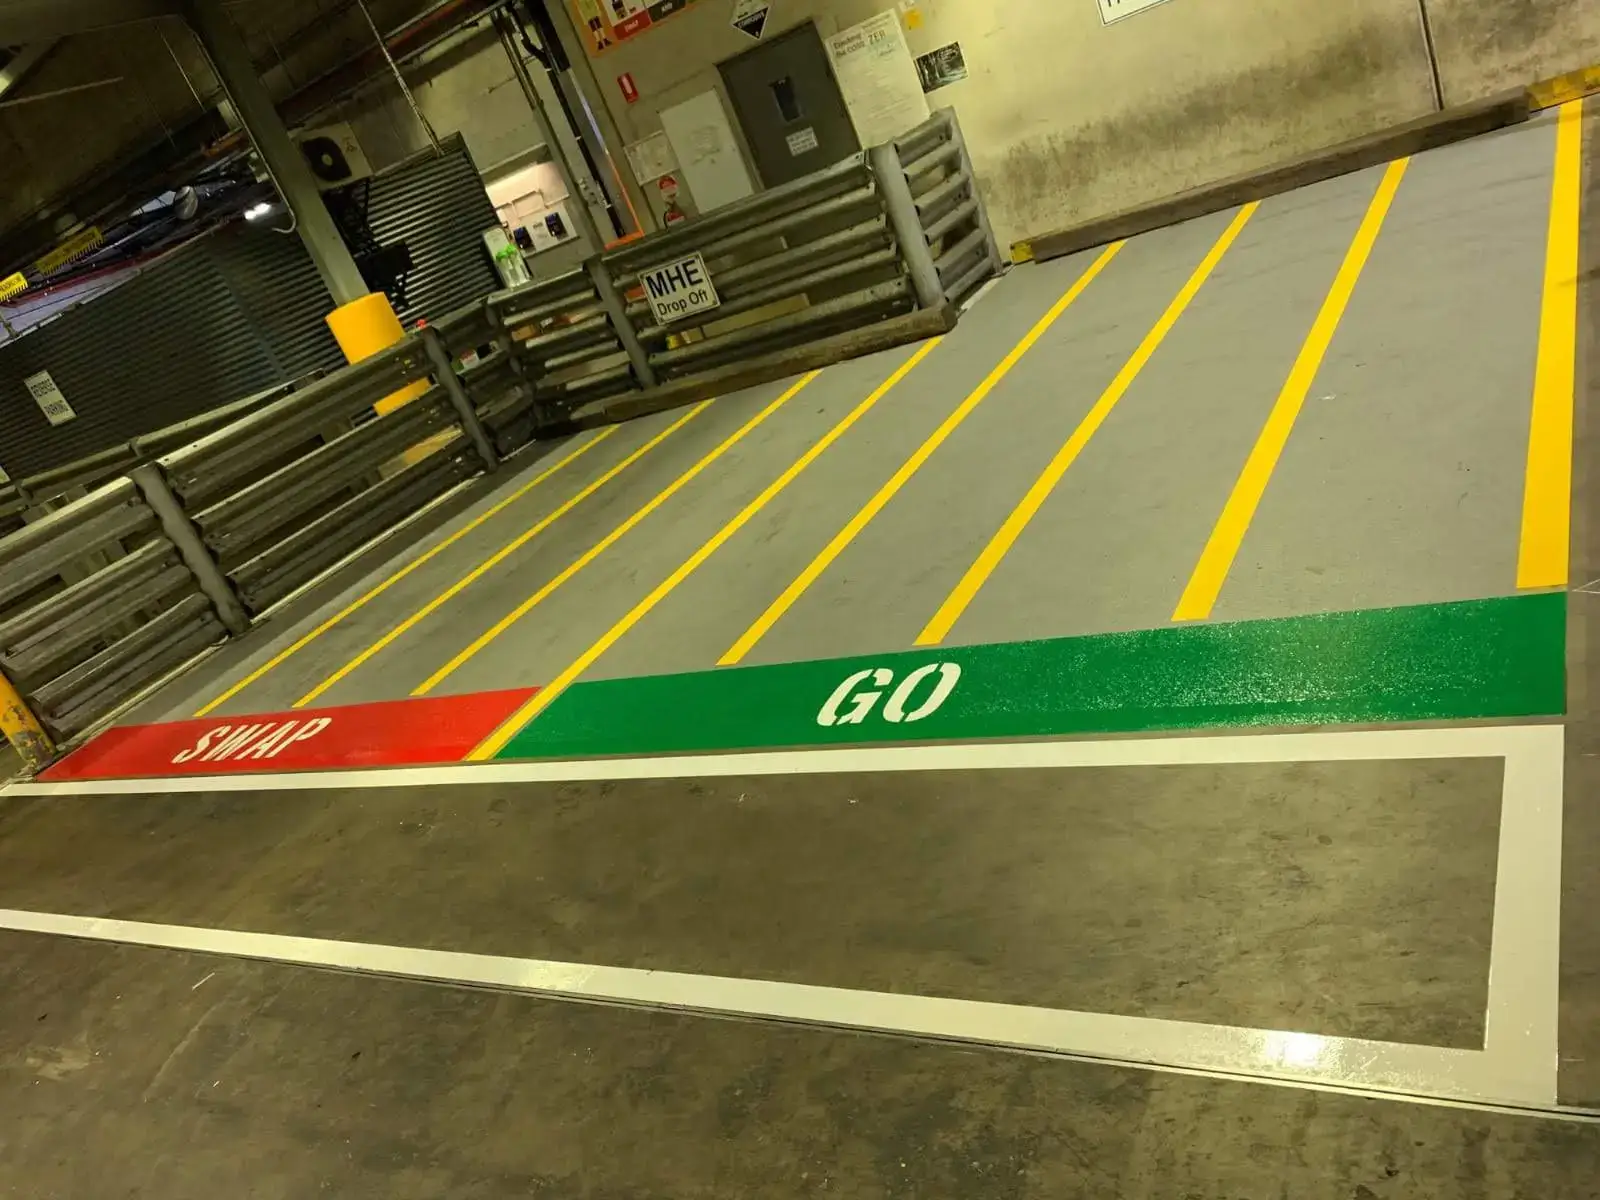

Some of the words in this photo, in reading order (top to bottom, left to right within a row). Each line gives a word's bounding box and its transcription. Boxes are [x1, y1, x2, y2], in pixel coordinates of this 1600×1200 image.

[646, 260, 703, 299] MHE
[657, 298, 687, 316] Drop
[816, 662, 961, 726] GO
[171, 717, 332, 764] SWAP
